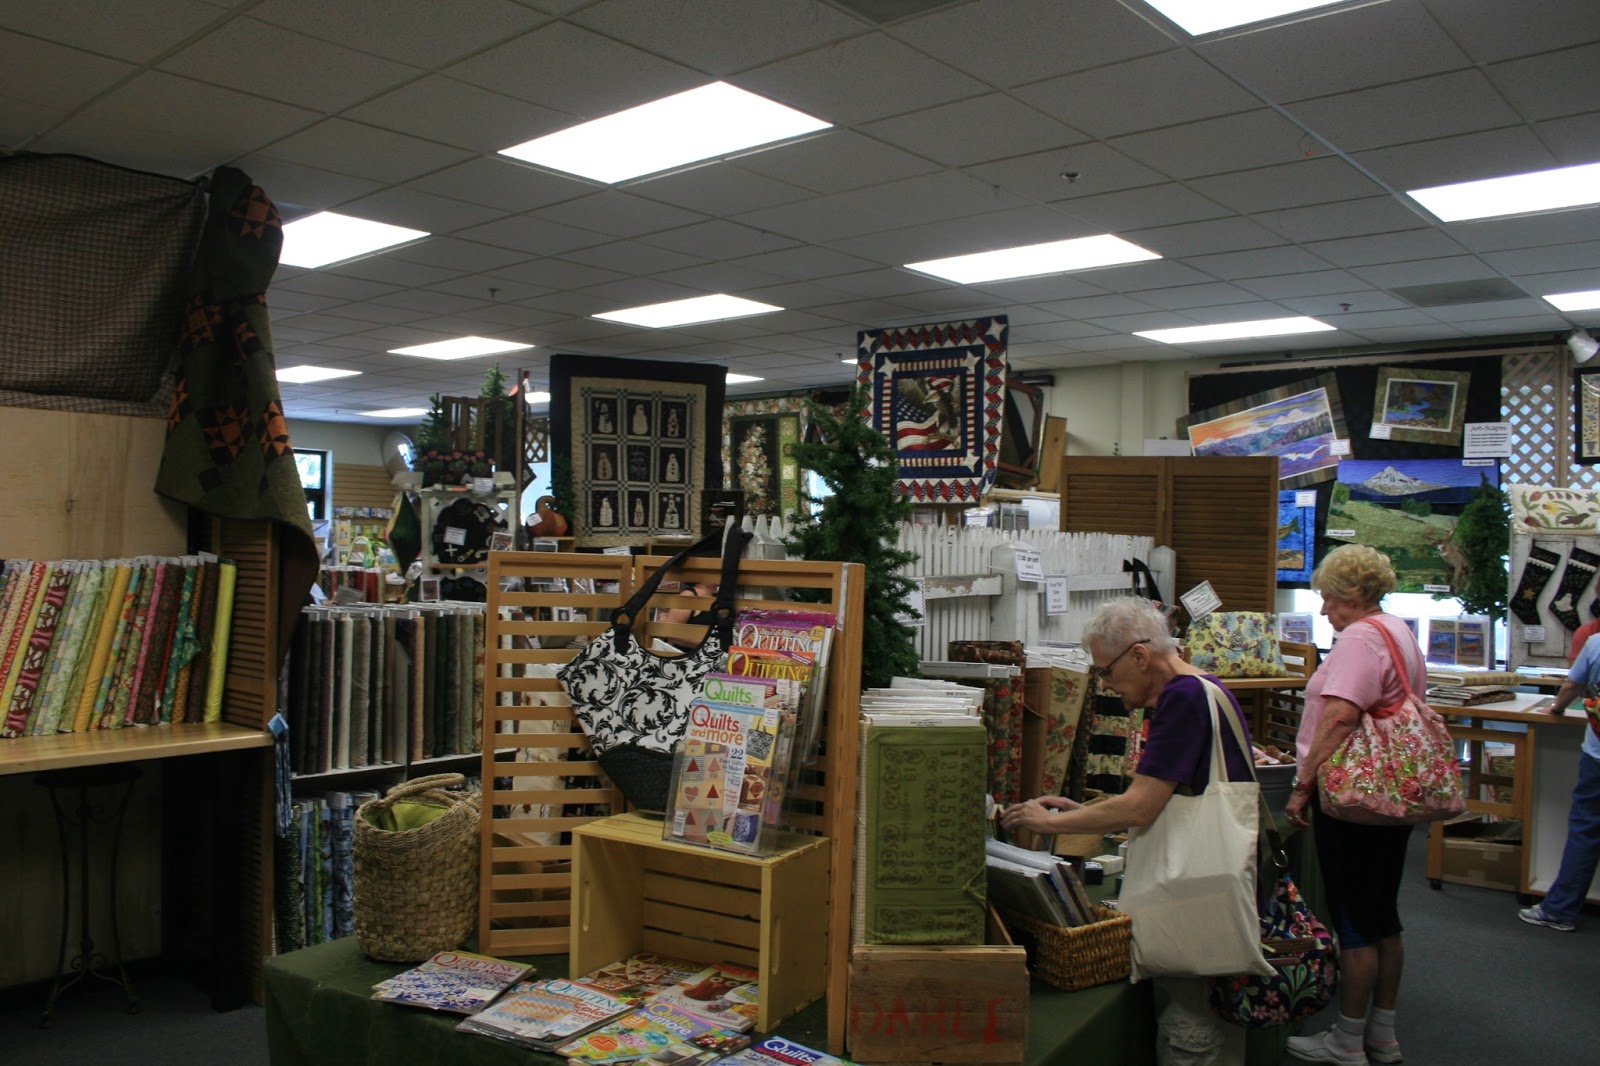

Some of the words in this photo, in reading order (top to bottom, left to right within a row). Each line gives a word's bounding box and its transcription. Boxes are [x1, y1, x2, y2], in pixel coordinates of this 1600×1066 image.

[728, 651, 809, 683] QUILTING
[705, 677, 752, 704] Quilts
[692, 704, 740, 732] Quilts
[691, 728, 706, 738] and
[706, 728, 744, 746] more
[730, 748, 744, 760] 22
[545, 980, 627, 1011] QUILTING
[649, 1003, 696, 1029] Quilts
[652, 1016, 692, 1036] more
[763, 1039, 816, 1063] Quilts
